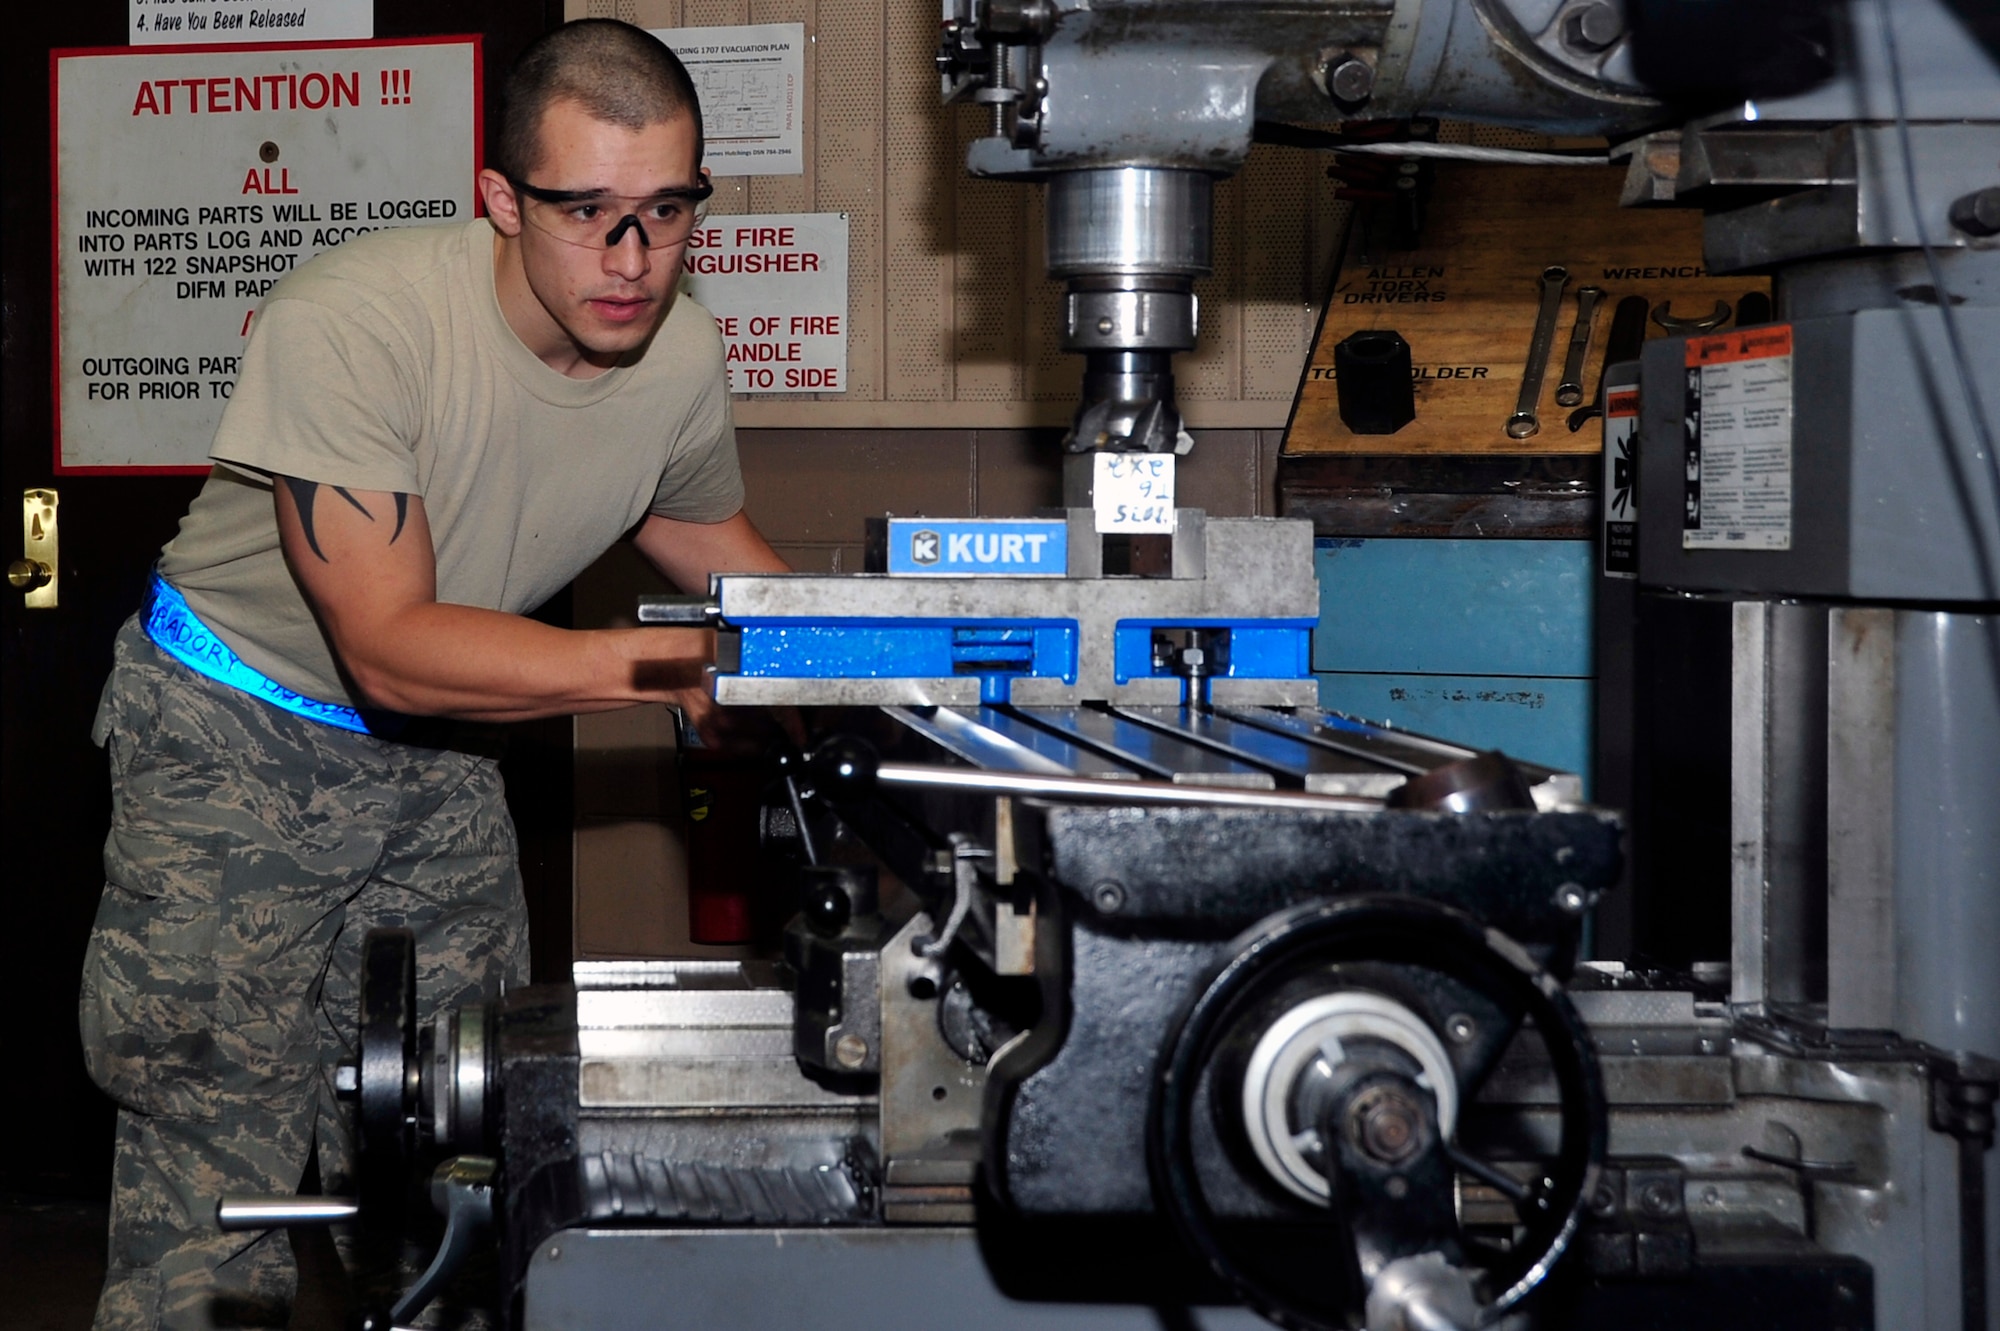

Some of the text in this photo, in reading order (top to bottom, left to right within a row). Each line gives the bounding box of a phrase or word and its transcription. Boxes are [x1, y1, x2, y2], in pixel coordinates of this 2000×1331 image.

[137, 8, 306, 32] 4. Have You Been Released
[672, 43, 790, 55] ILDING 1707 EVACUATION PLAN
[133, 69, 411, 116] ATTENTION !!!
[242, 168, 298, 194] ALL
[87, 200, 457, 228] INCOMING PARTS WILL BE LOGGED
[79, 234, 125, 253] INTO
[134, 232, 198, 251] PARTS
[208, 230, 250, 249] LOG
[260, 229, 302, 248] AND
[736, 228, 794, 247] FIRE
[84, 254, 298, 276] WITH 122 SNAPSHOT
[681, 253, 819, 274] NGUISHER
[1366, 267, 1444, 279] ALLEN
[1603, 266, 1709, 280] WRENCH
[177, 279, 280, 299] DIFM PAP
[1369, 280, 1430, 292] TORX
[1344, 291, 1447, 304] DRIVERS
[749, 317, 781, 336] OF
[790, 316, 840, 336] FIRE
[726, 343, 802, 362] ANDLE
[82, 357, 189, 377] OUTGOING
[1411, 367, 1489, 380] OLDER
[744, 369, 774, 388] TO
[784, 368, 838, 388] SIDE
[88, 382, 129, 400] FOR
[139, 381, 200, 400] PRIOR
[948, 533, 1048, 563] KURT
